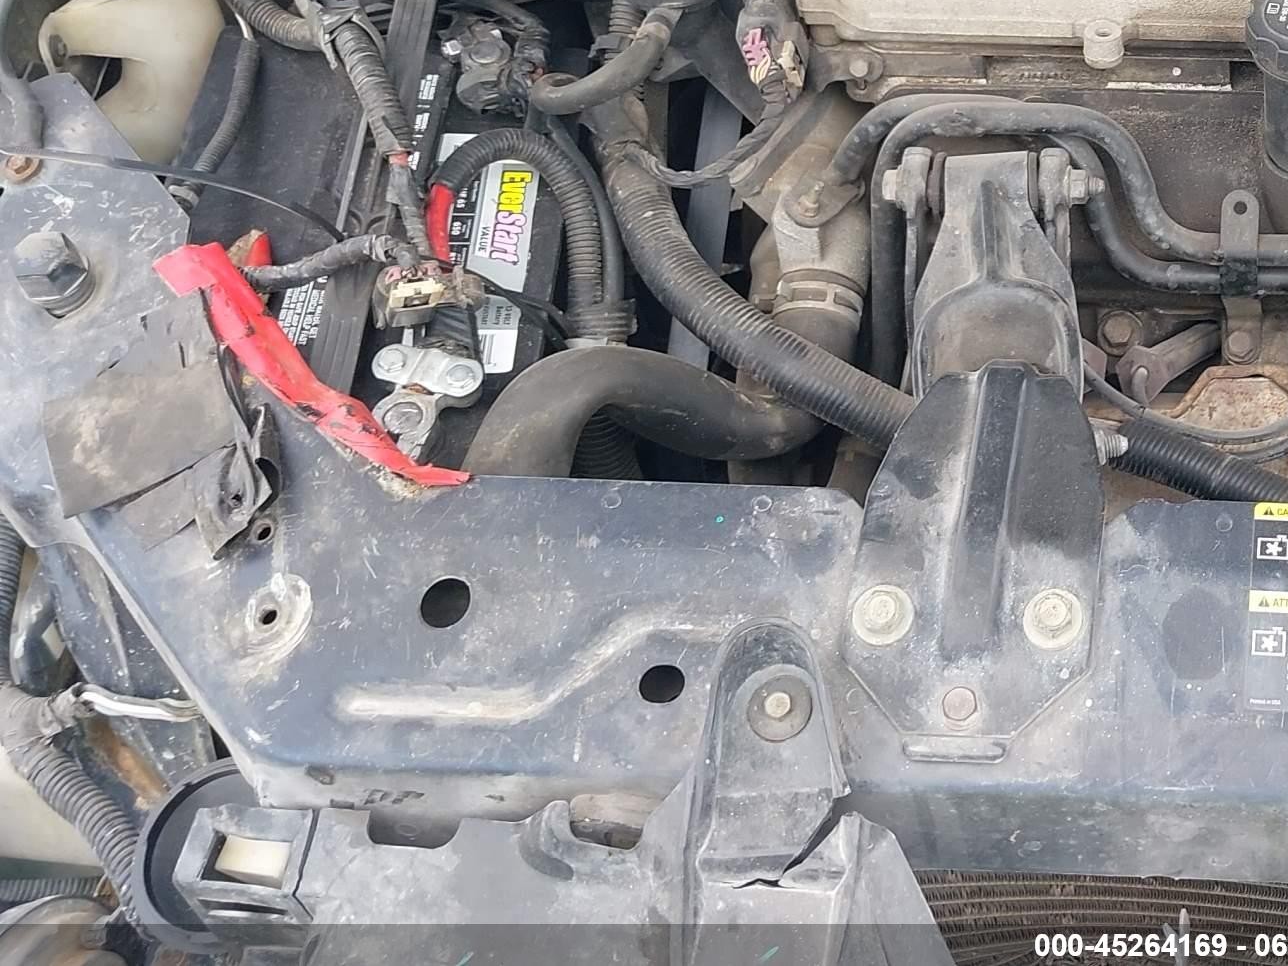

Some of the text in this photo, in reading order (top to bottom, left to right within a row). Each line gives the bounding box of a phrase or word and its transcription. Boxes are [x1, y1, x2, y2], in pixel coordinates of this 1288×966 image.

[451, 221, 463, 236] 650
[490, 169, 533, 265] EverStart
[477, 226, 491, 253] VALUE
